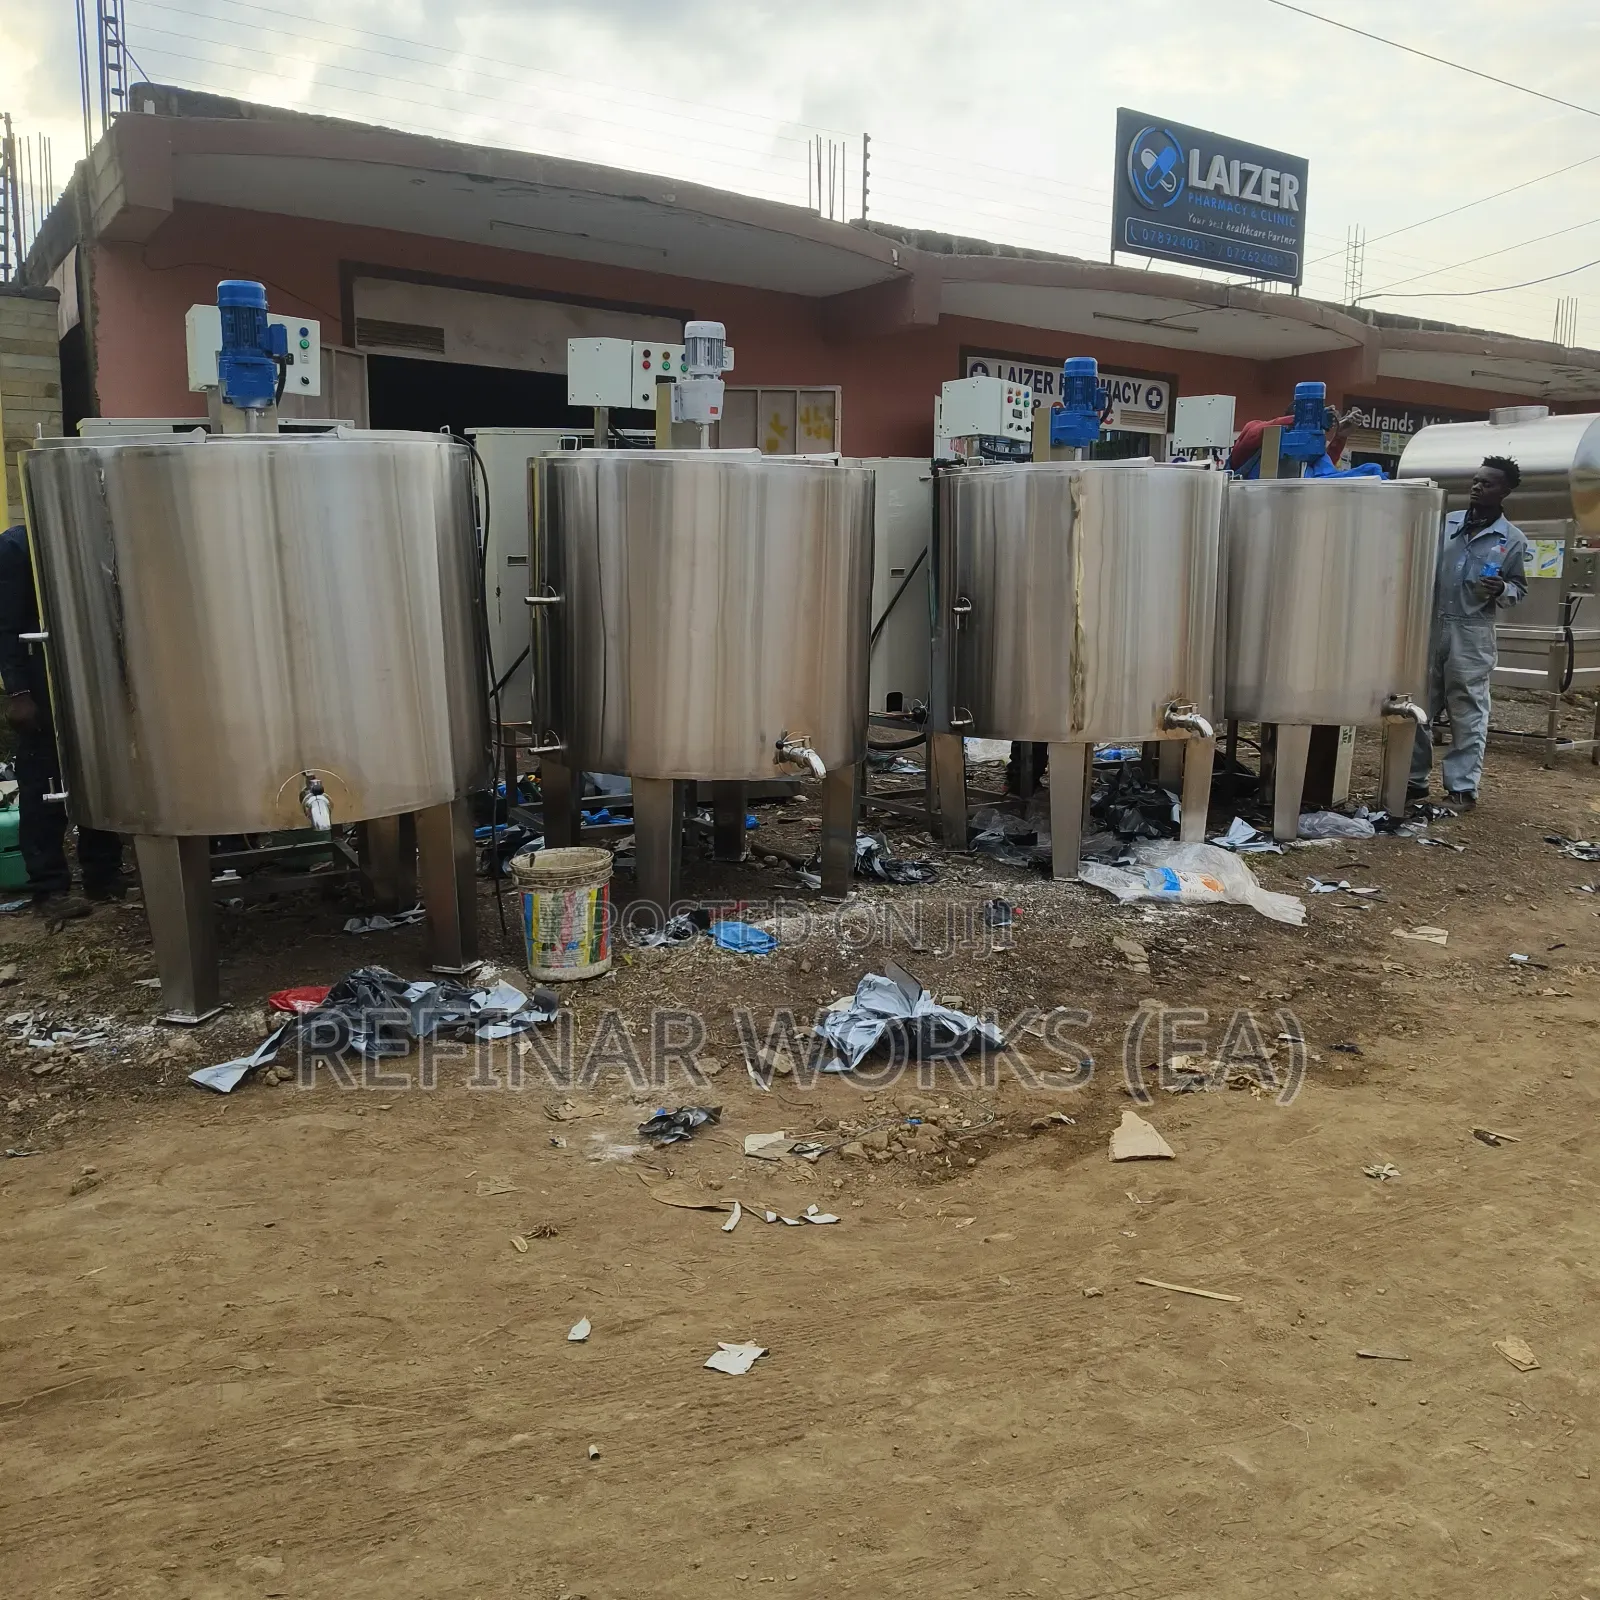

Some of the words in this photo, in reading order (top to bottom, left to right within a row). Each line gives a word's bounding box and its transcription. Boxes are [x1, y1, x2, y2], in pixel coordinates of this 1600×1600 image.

[1188, 148, 1299, 211] LAIZER
[1188, 192, 1248, 216] PHARMACY
[1260, 209, 1296, 228] CLINIC
[1188, 212, 1205, 227] Your
[1226, 220, 1266, 240] healthcare
[1268, 230, 1297, 245] Partner
[1059, 374, 1142, 405] PMACY
[1353, 407, 1414, 433] elrands
